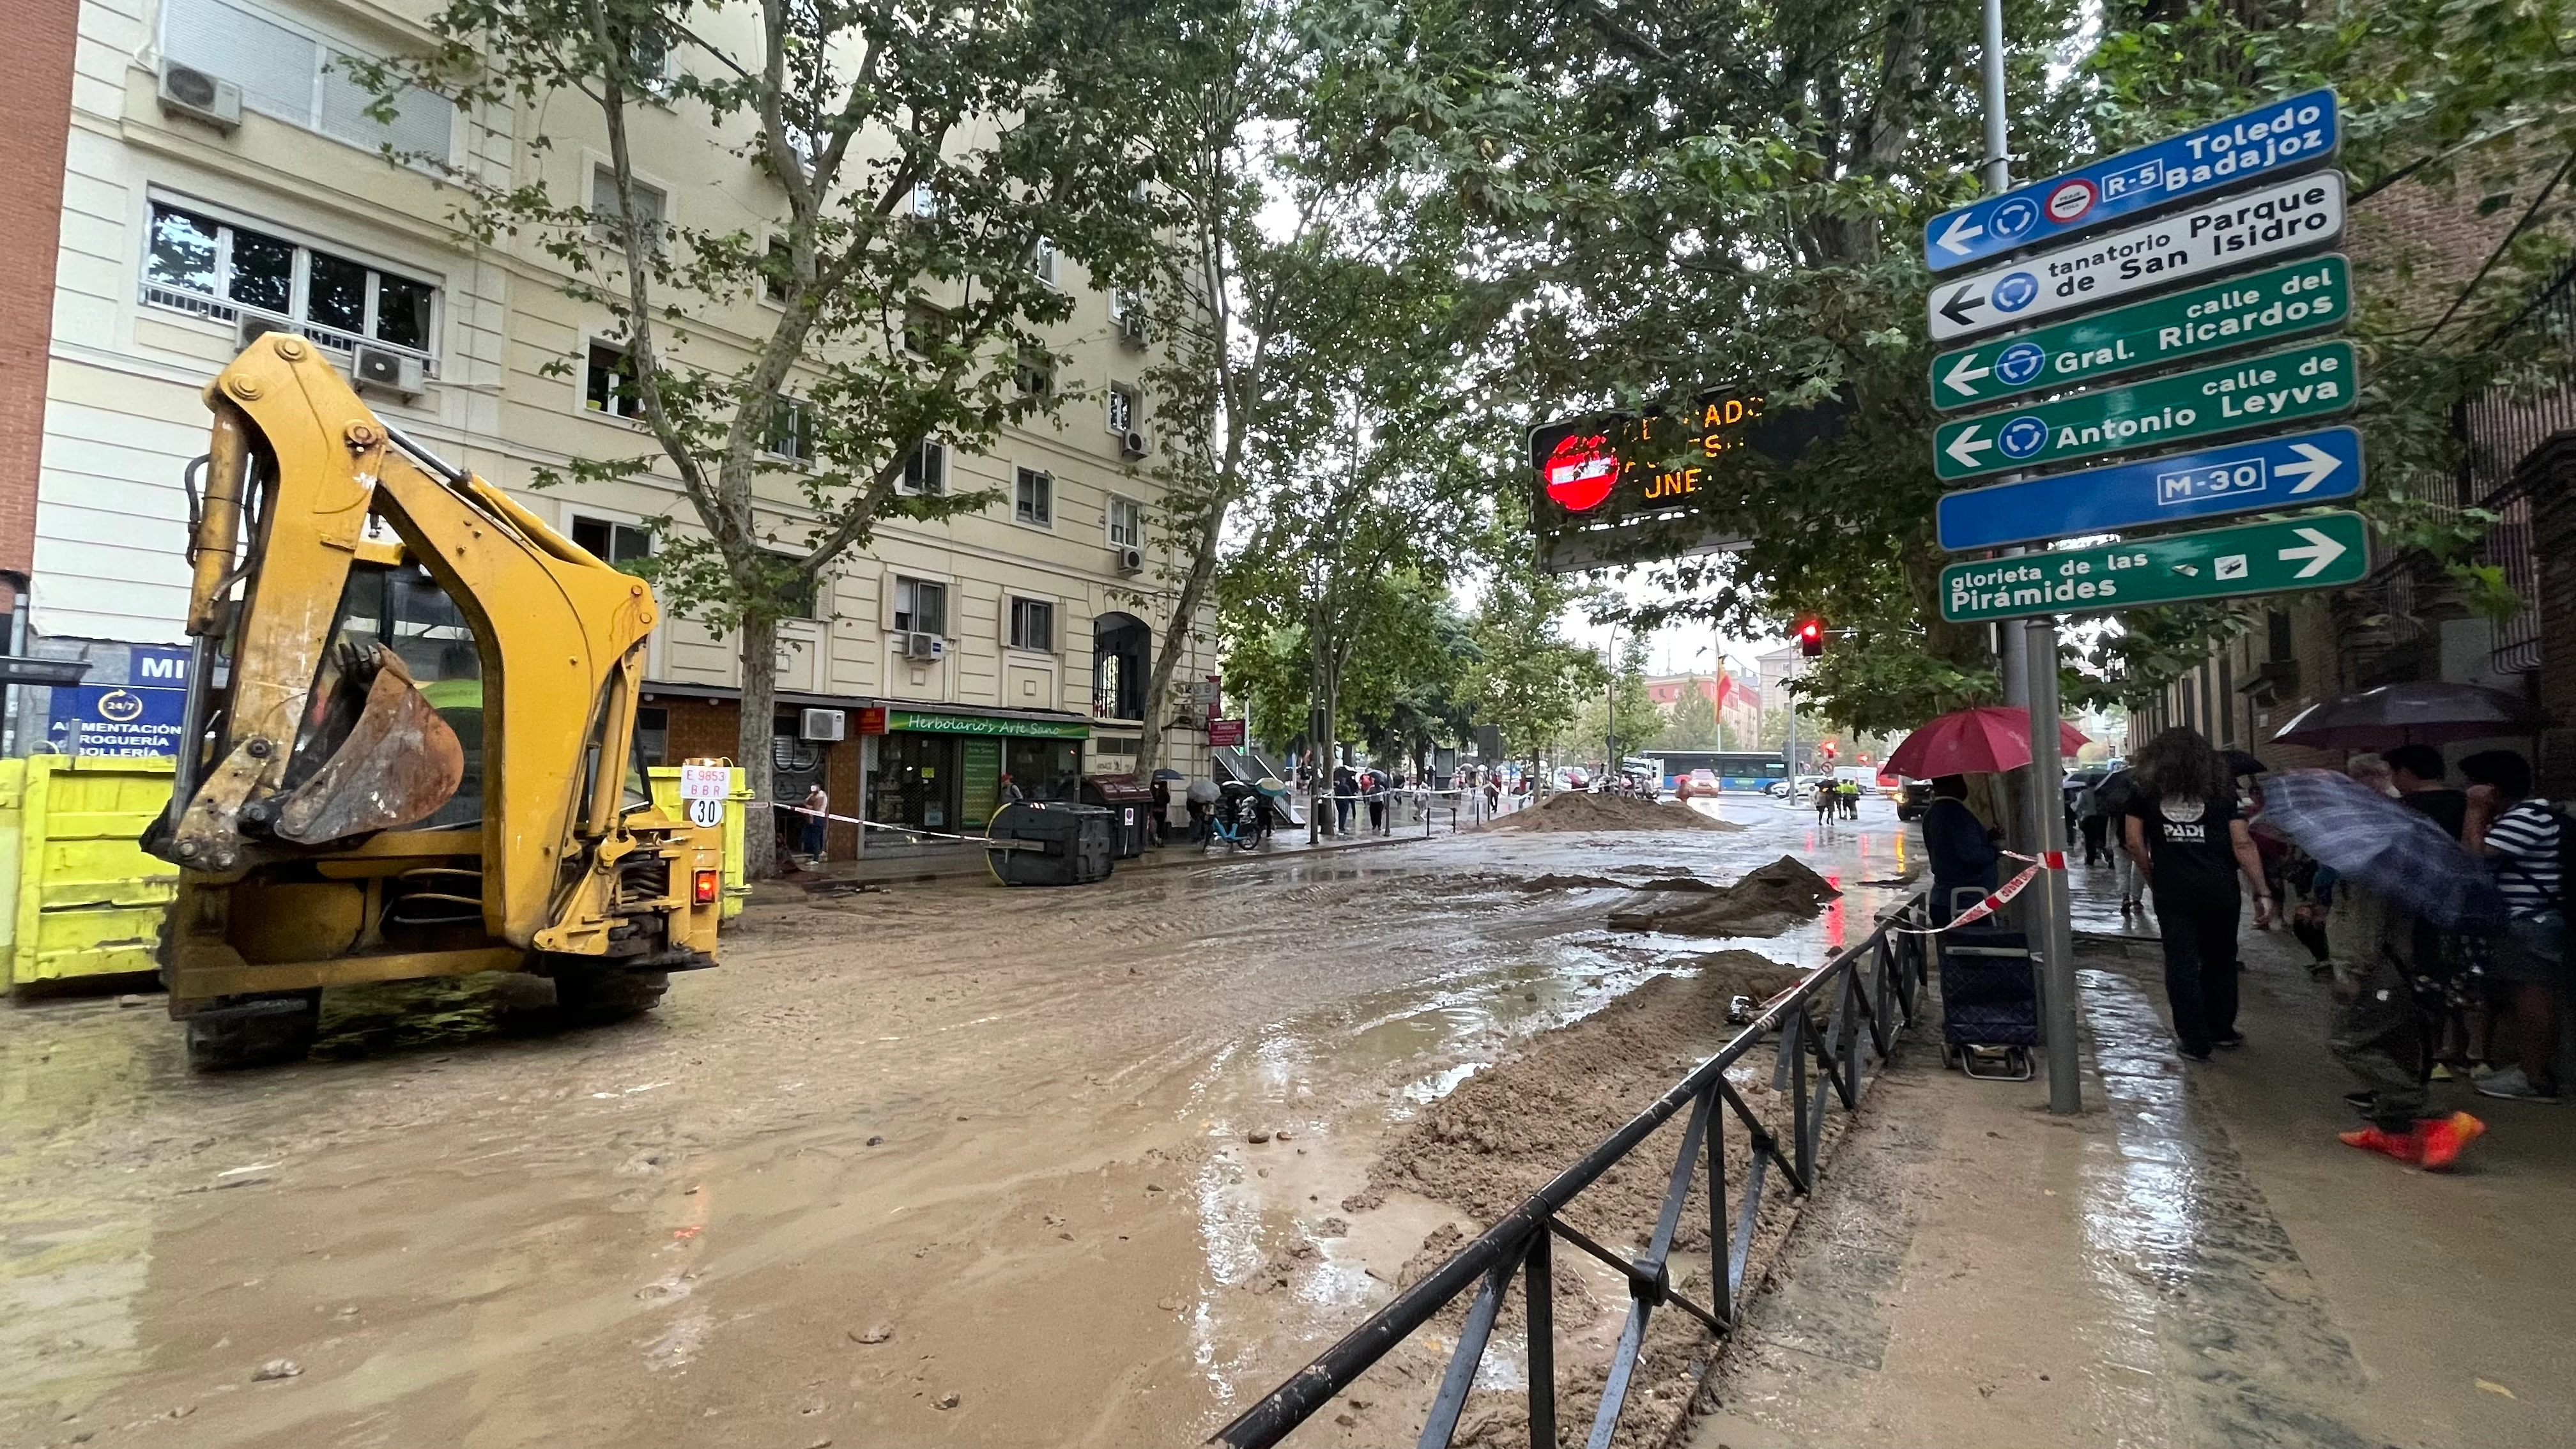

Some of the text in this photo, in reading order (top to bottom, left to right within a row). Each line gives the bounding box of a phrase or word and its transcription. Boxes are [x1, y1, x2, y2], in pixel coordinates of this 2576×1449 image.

[2186, 104, 2321, 160] Toledo
[2166, 128, 2323, 192] Badajoz
[2108, 168, 2156, 196] R-5
[2048, 187, 2326, 277] tanatorio Parque
[2055, 211, 2327, 298] de San Isidro
[2186, 268, 2333, 319] calle del
[2055, 295, 2334, 373] Gral. Ricardos
[2202, 356, 2338, 396] calle de
[2056, 381, 2339, 449] Antonio Leyva
[2165, 466, 2258, 500] M-30
[1951, 552, 2148, 595] glorieta de las
[1952, 578, 2117, 613] Pirámides
[107, 701, 135, 712] 24/7
[52, 721, 181, 735] AMENTACIÓN
[79, 734, 169, 746] ROGUERÍA
[999, 721, 1026, 734] Arte
[1030, 723, 1059, 735] Sano
[687, 770, 724, 781] E 9853
[698, 801, 715, 823] 30
[2163, 824, 2205, 837] PADI
